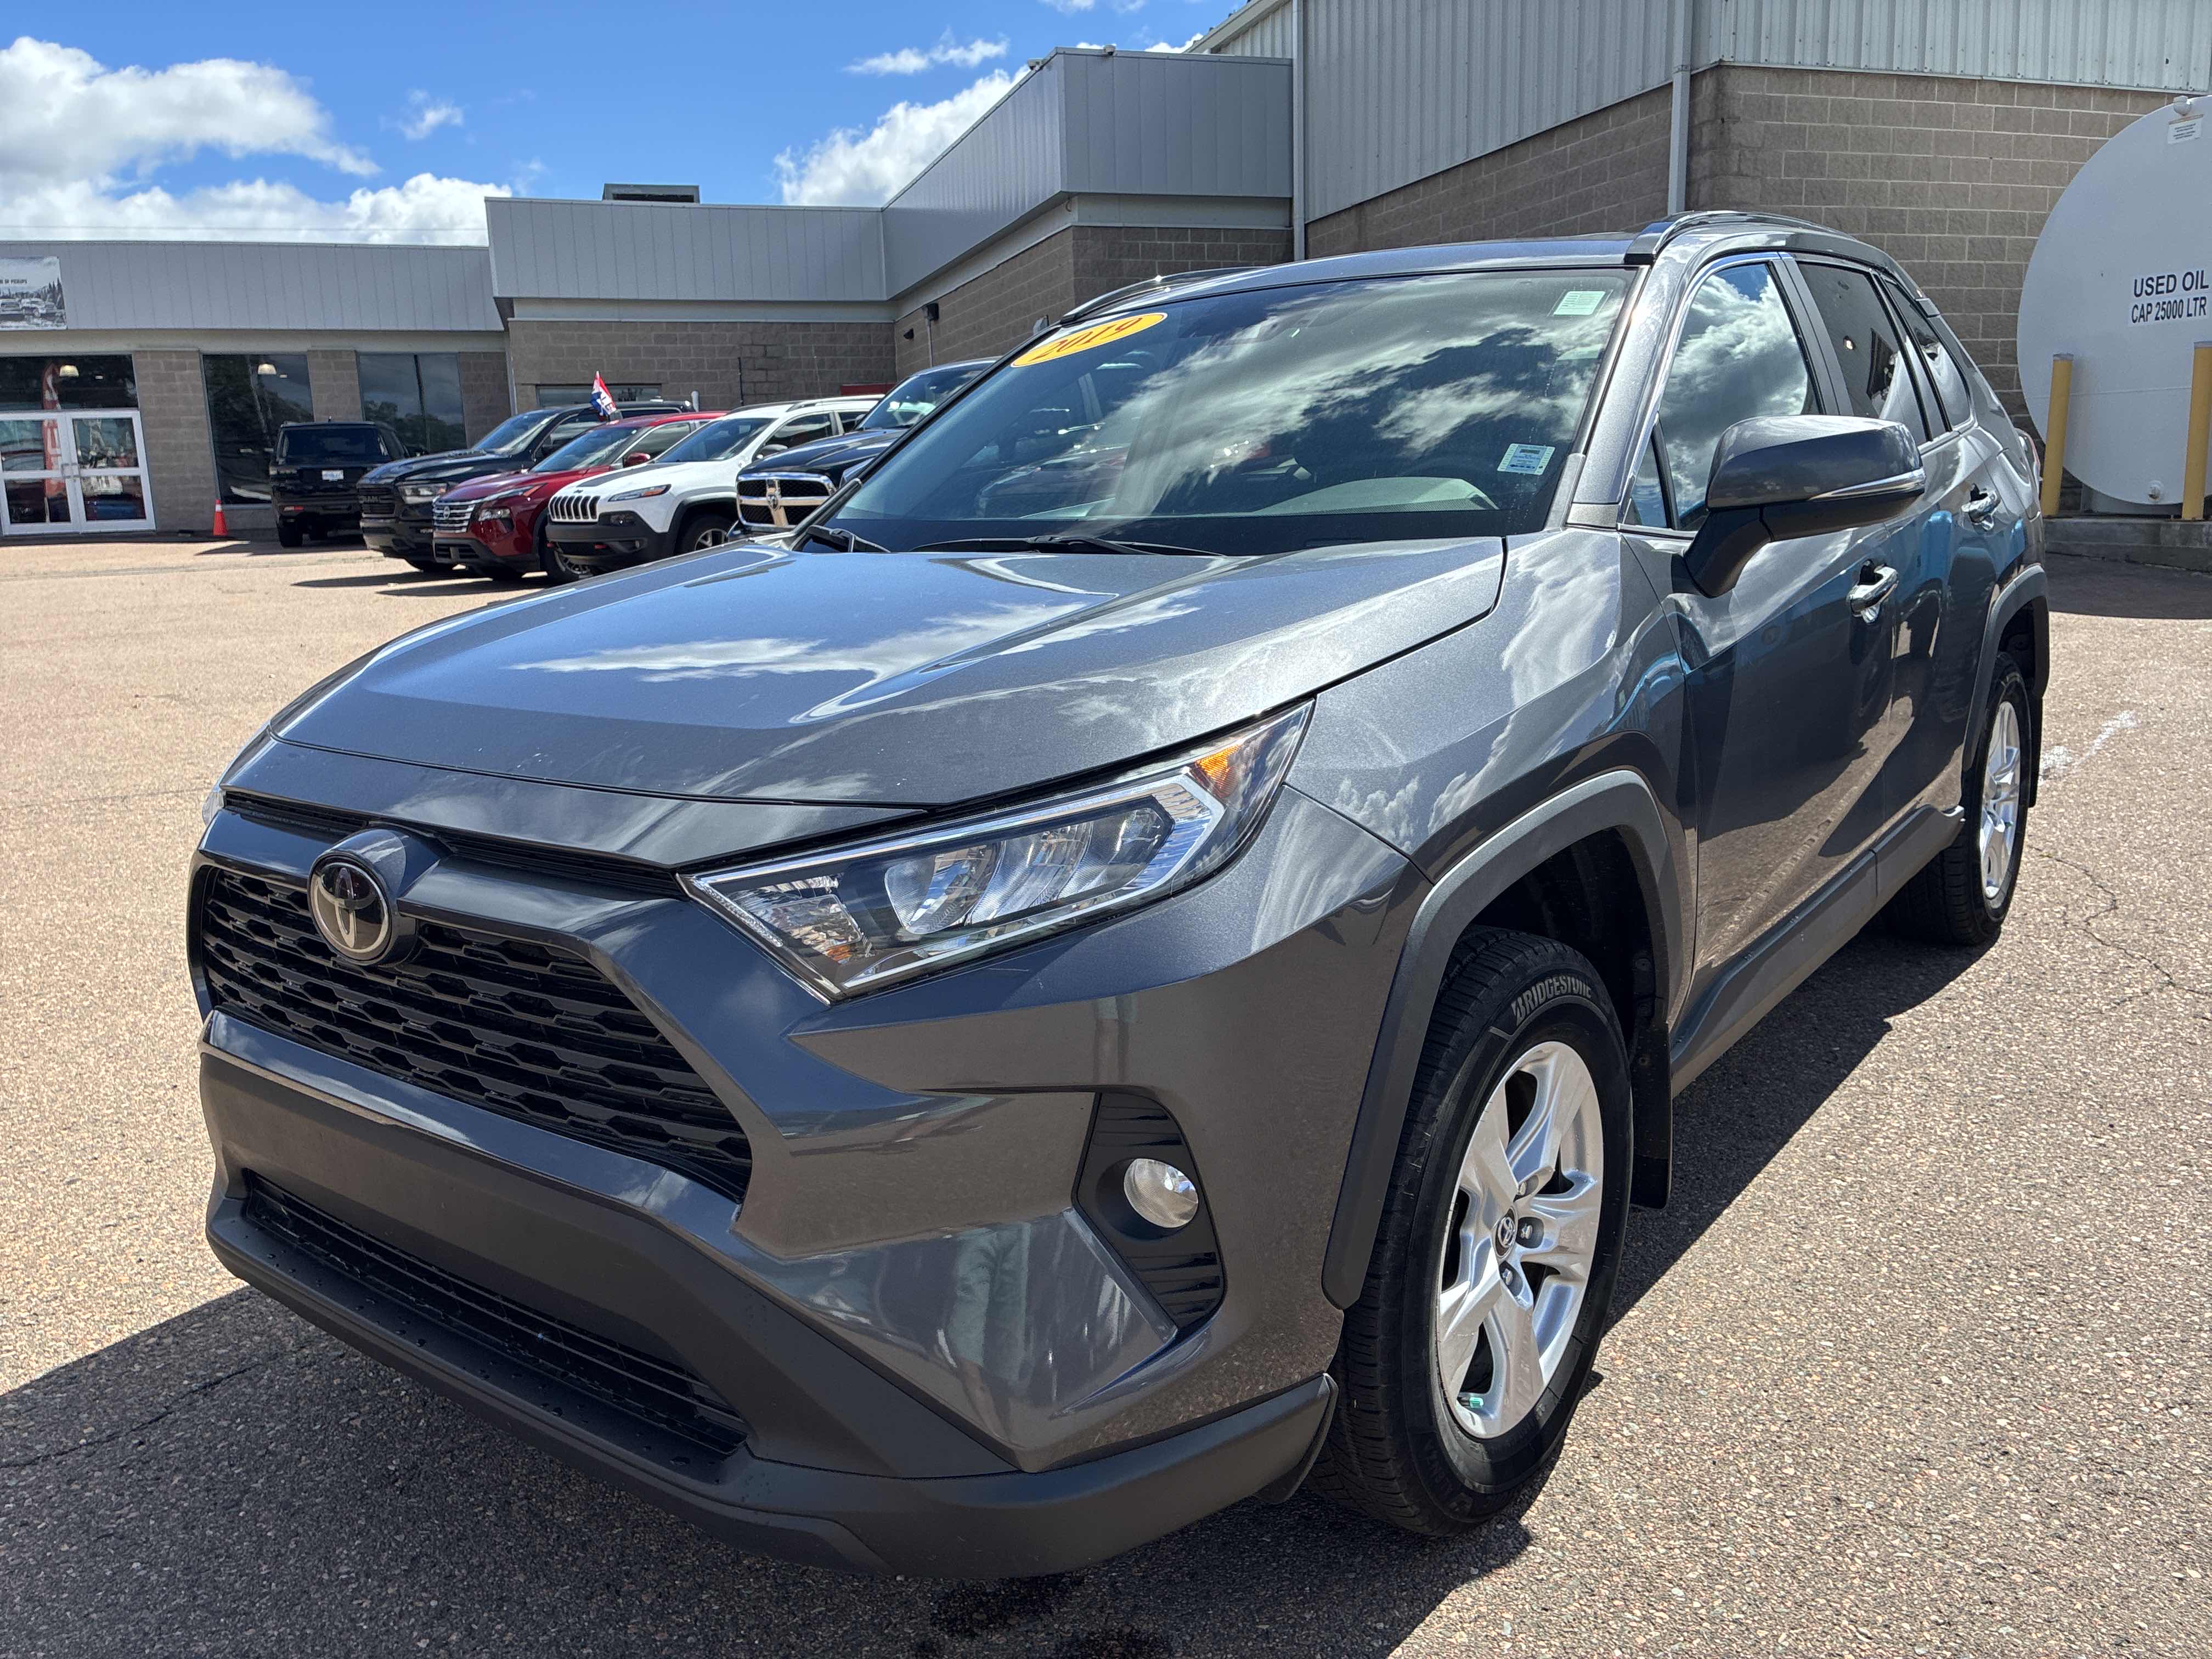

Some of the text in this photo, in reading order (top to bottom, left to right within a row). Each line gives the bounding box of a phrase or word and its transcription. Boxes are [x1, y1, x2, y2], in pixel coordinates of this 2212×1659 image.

[2134, 269, 2209, 298] USED OIL
[2131, 296, 2207, 324] CAP 25000 LTR
[1028, 317, 1143, 362] 2019
[1510, 974, 1593, 1027] BRIDGESTONE
